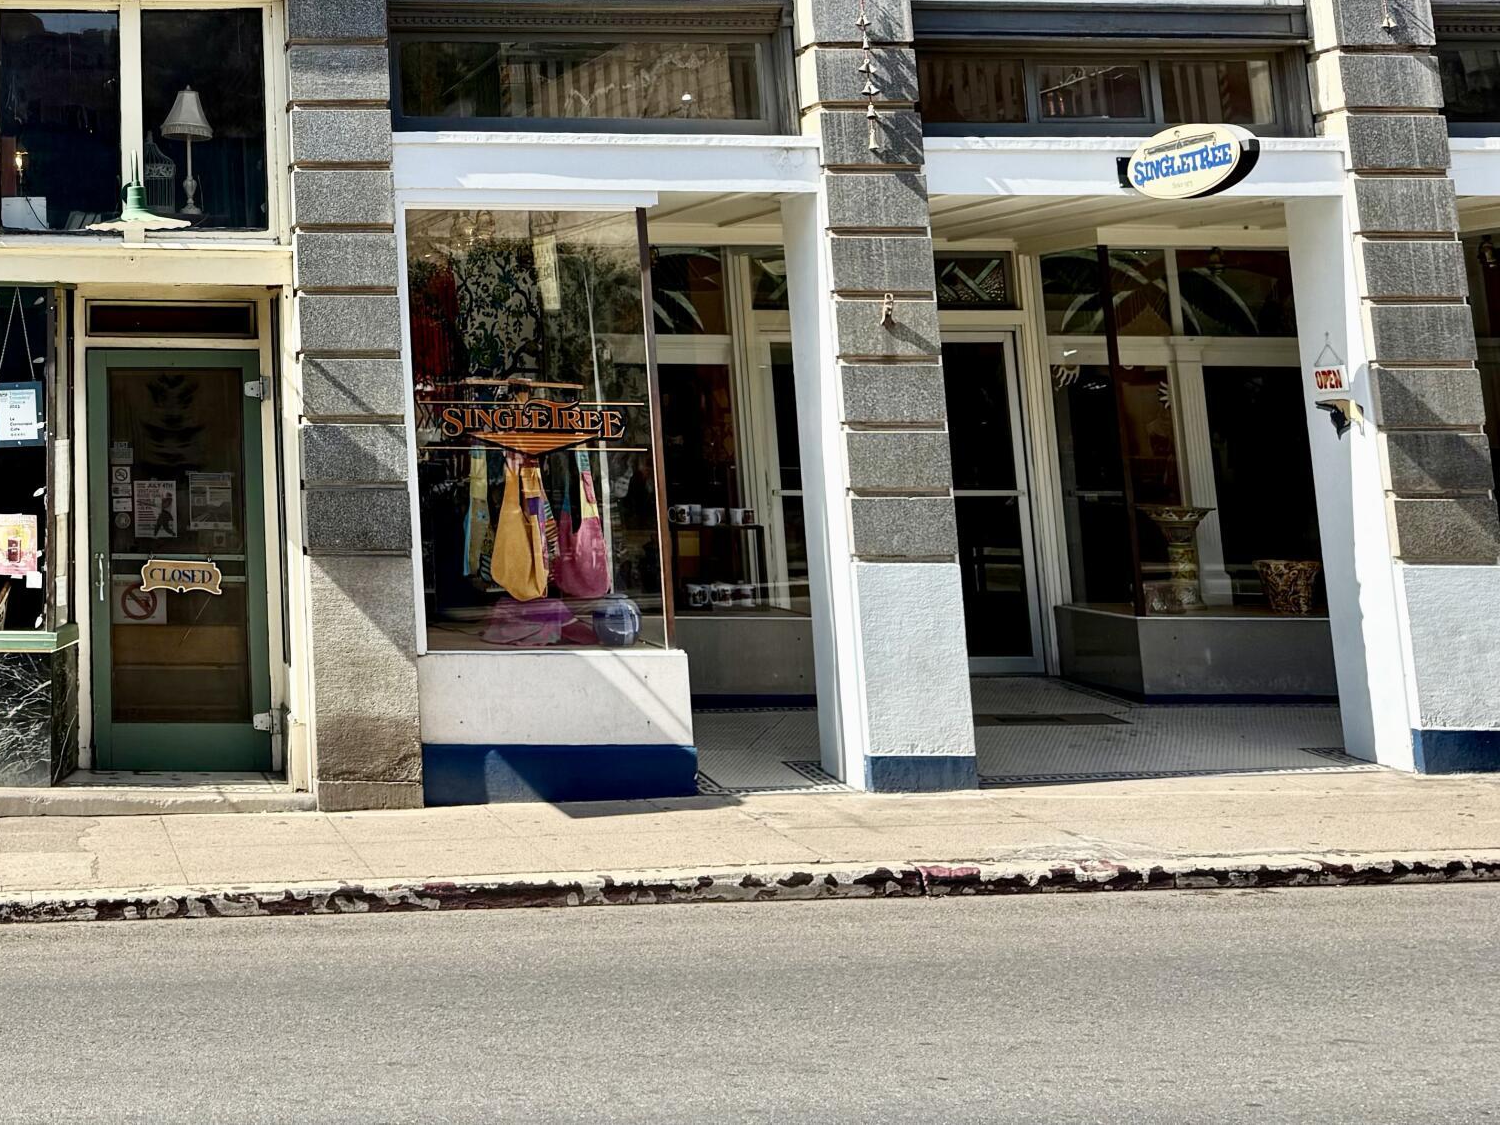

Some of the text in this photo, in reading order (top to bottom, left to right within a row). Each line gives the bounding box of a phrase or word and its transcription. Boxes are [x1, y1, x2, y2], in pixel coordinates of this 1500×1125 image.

[1134, 143, 1233, 187] SINGLETREE
[1315, 369, 1343, 390] OPEN
[149, 567, 213, 584] CLOSED
